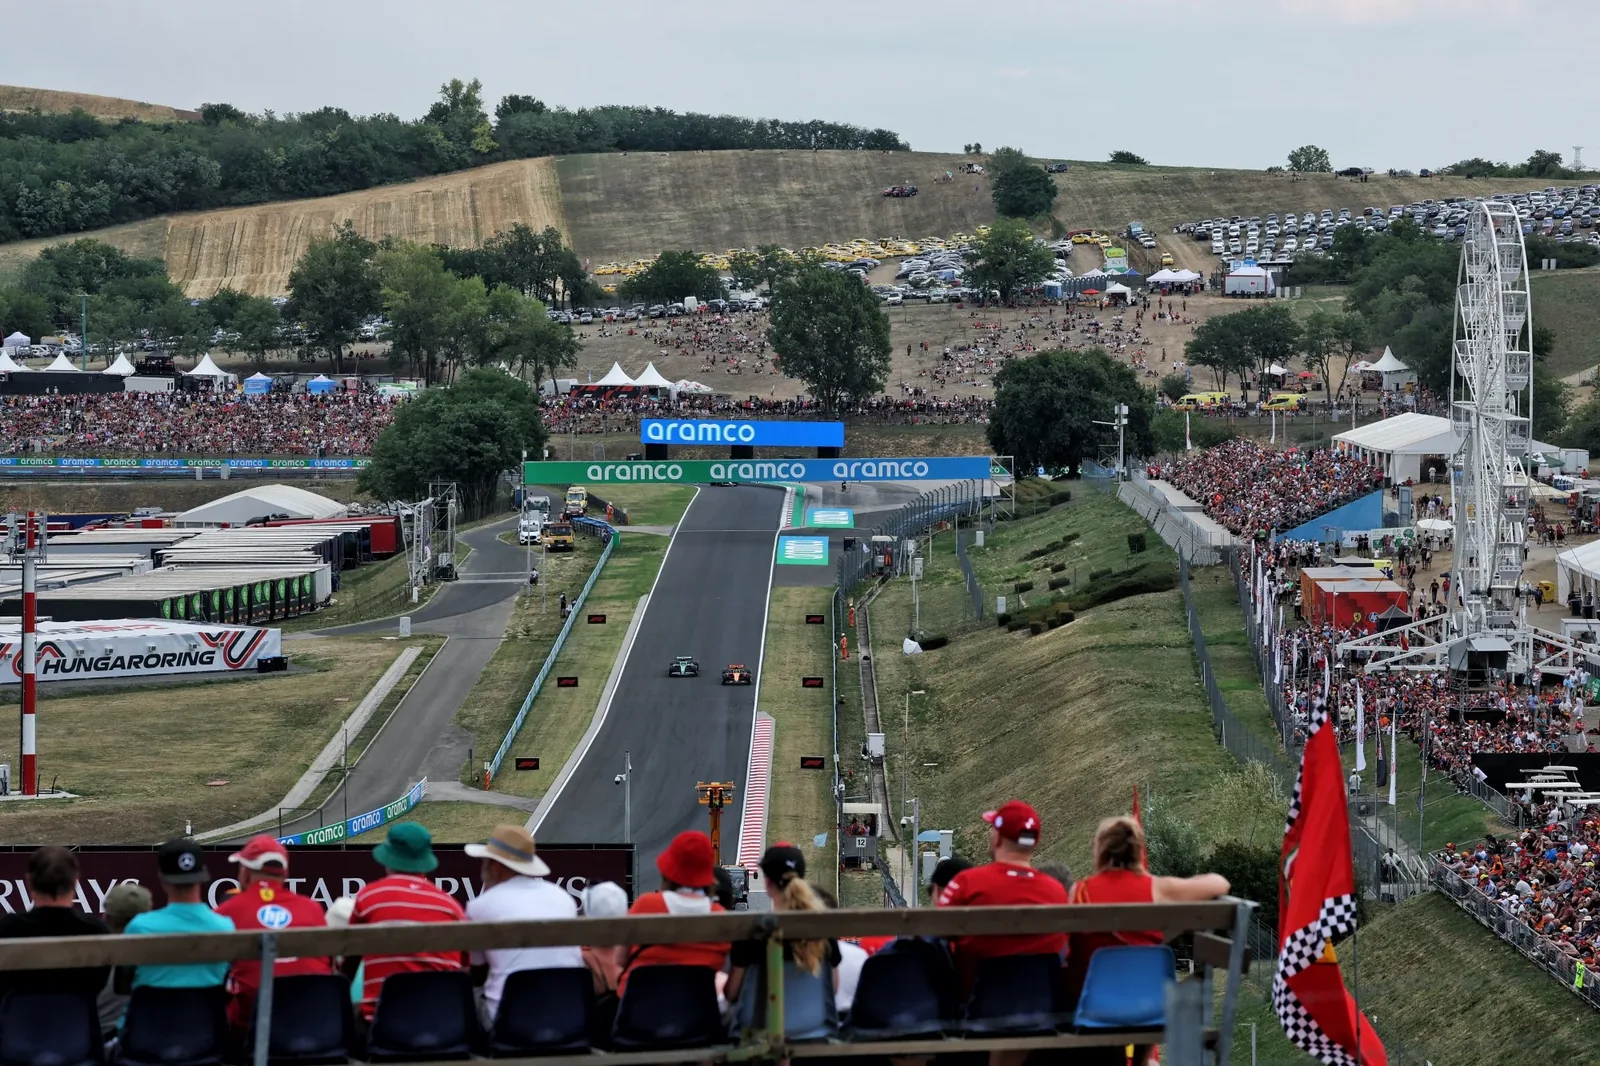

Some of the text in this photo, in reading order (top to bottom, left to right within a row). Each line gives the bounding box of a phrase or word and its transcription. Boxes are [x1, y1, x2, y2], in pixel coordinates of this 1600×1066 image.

[647, 422, 756, 442] aramco
[62, 458, 95, 466] aramco
[709, 463, 806, 479] aramco
[832, 461, 929, 477] aramco
[586, 464, 683, 480] aramco
[42, 650, 216, 675] HUNGARORING
[387, 798, 408, 818] aramco
[352, 811, 381, 832] aramco
[307, 825, 344, 844] aramco
[265, 905, 286, 928] hp
